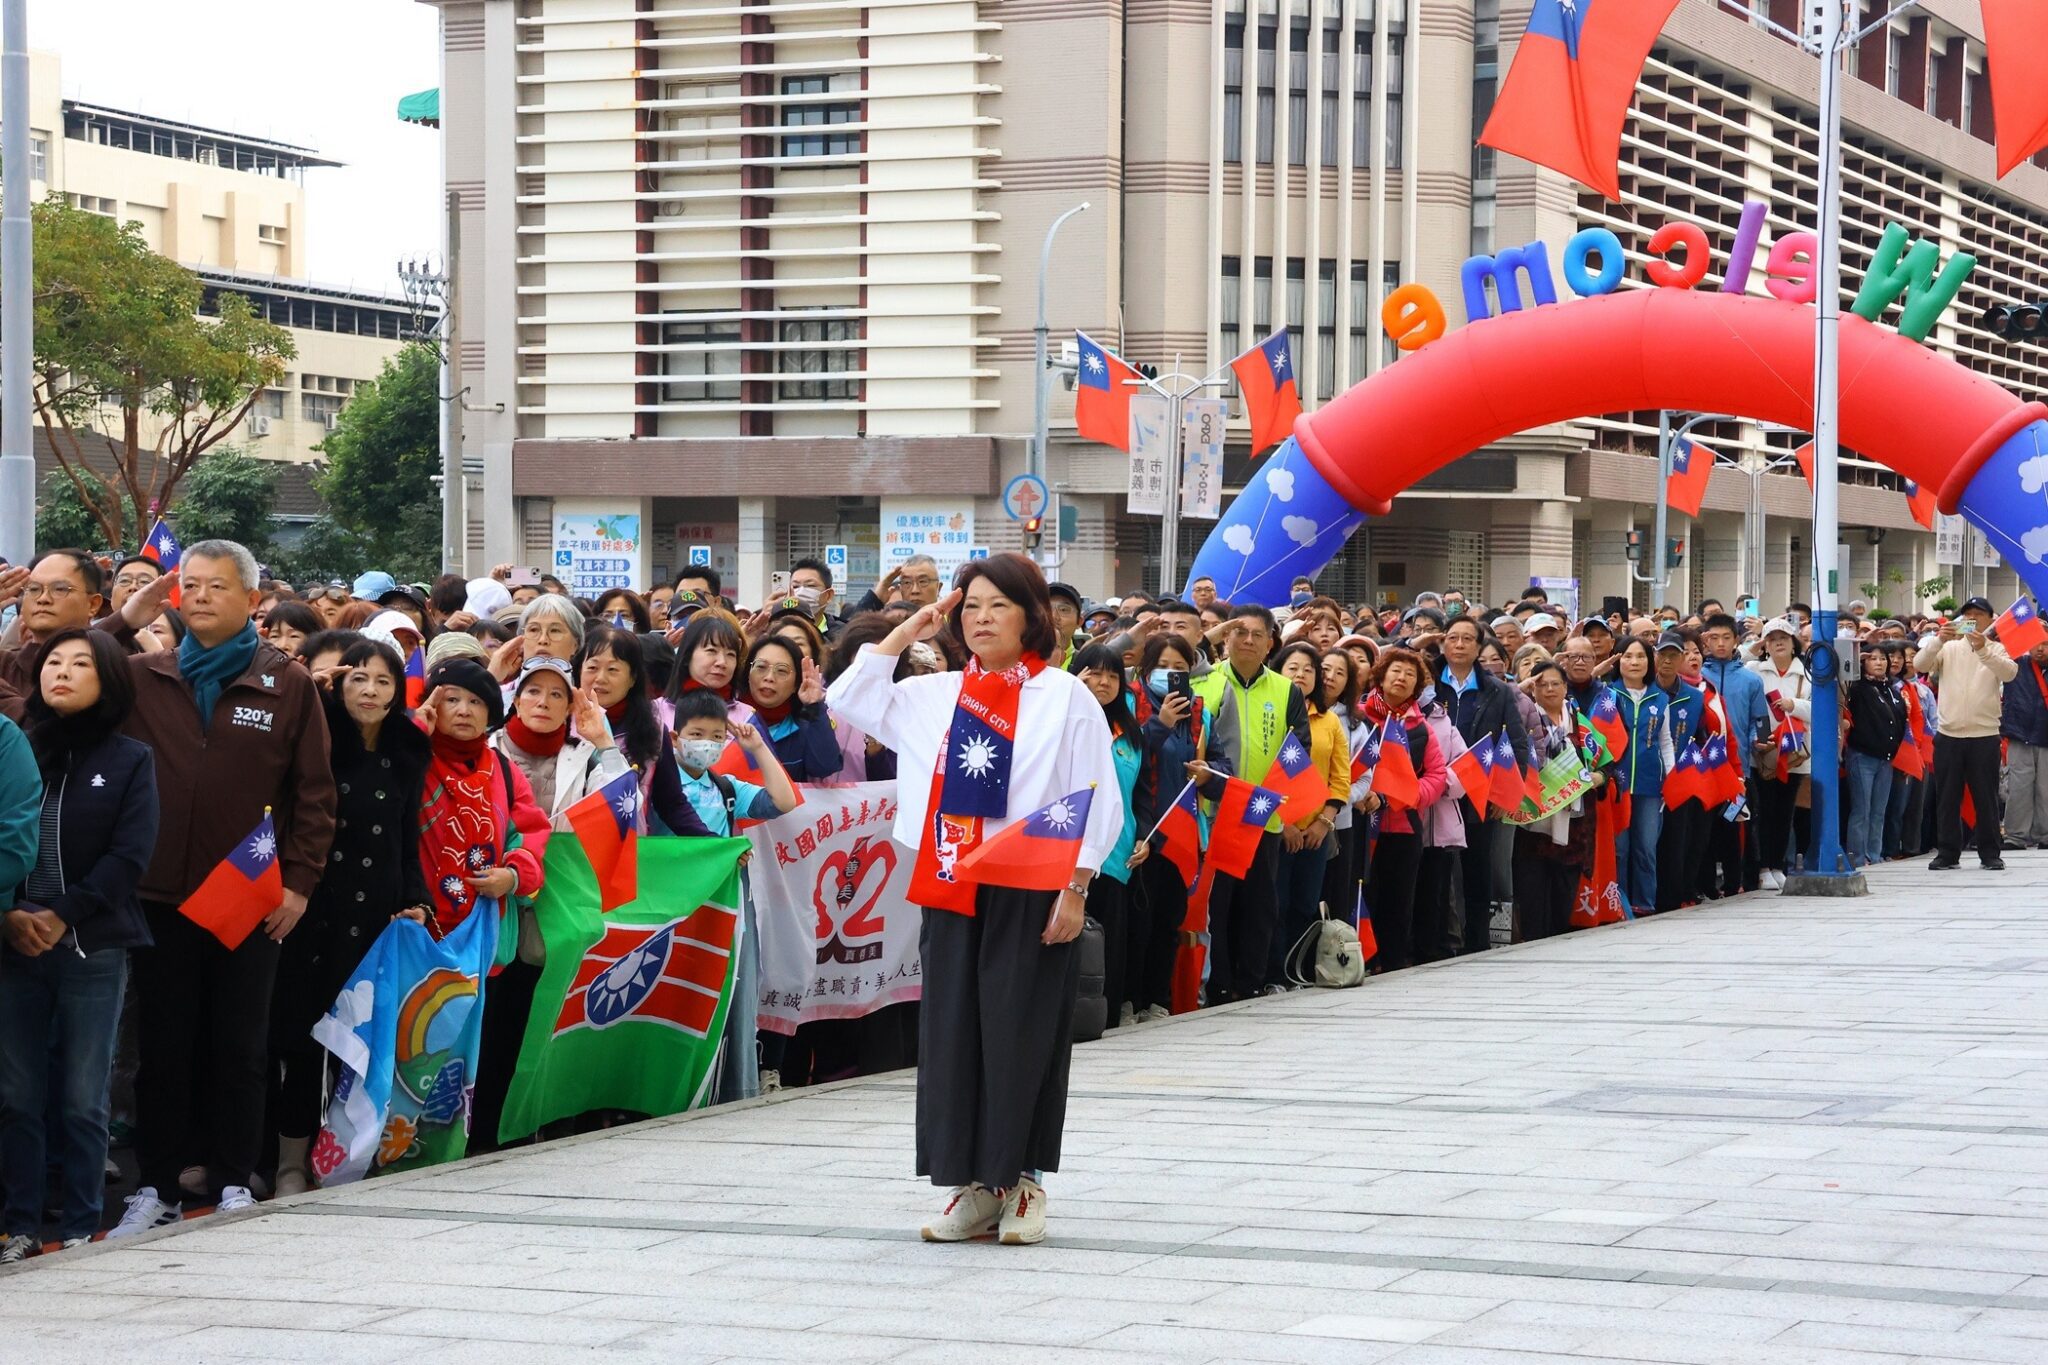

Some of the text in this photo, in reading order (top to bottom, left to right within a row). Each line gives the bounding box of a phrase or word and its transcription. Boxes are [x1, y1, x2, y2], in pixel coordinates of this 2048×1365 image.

[928, 531, 969, 544] 省得到
[960, 693, 1011, 732] CHIAYI CITY
